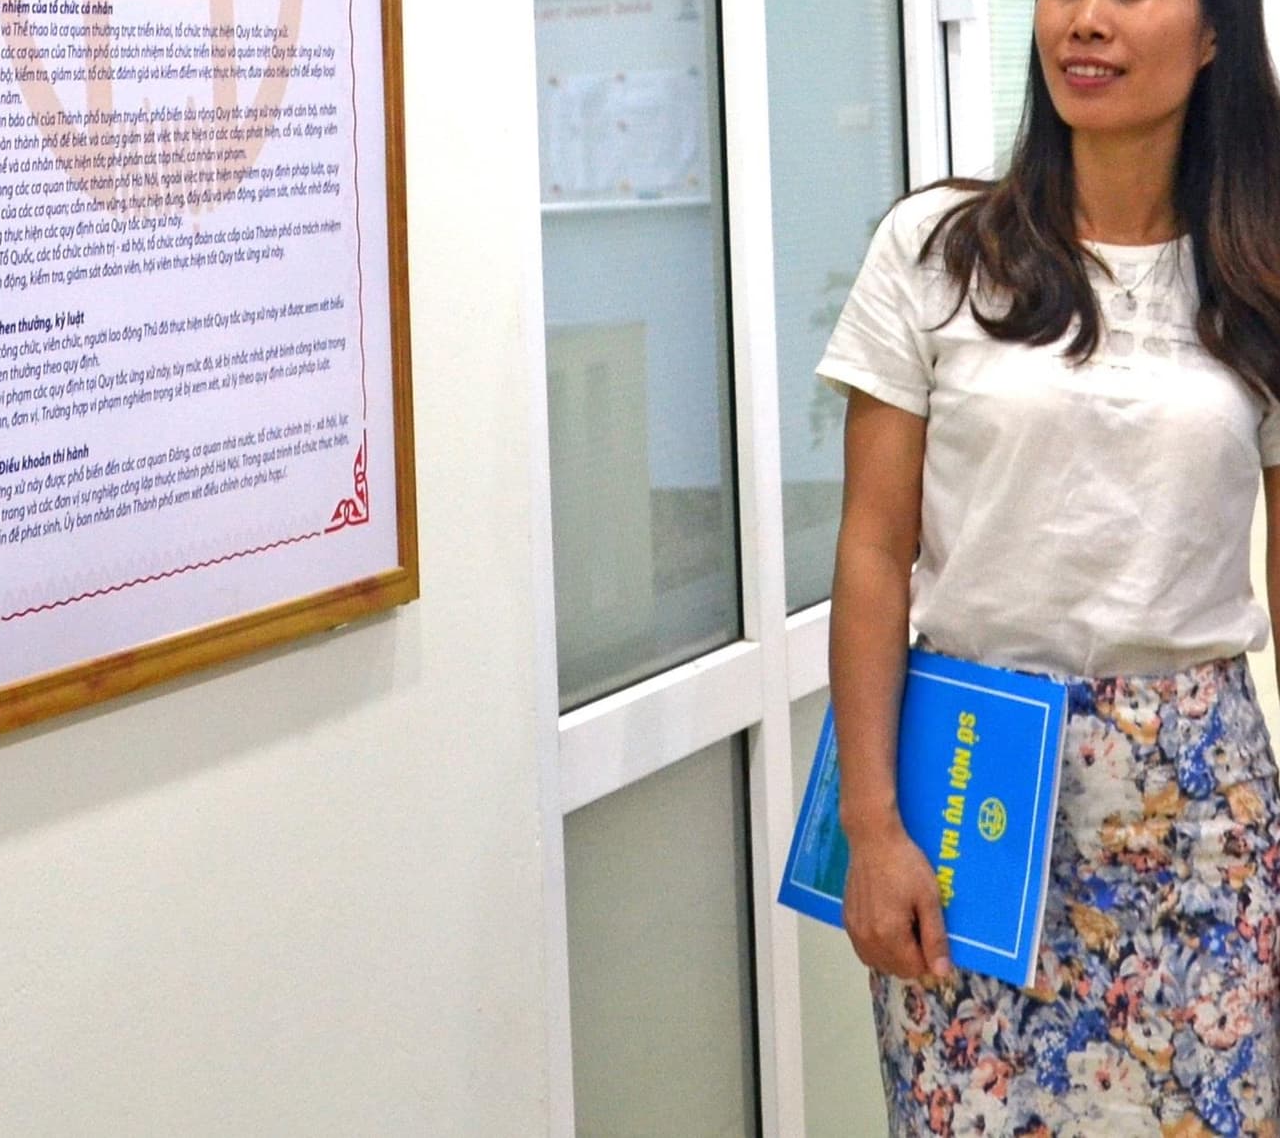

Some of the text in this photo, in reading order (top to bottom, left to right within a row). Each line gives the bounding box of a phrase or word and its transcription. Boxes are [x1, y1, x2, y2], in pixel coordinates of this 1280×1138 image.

[958, 710, 981, 745] SỞ
[948, 747, 973, 790] NỘI
[941, 795, 965, 825] VỤ
[939, 829, 960, 860] HÀ
